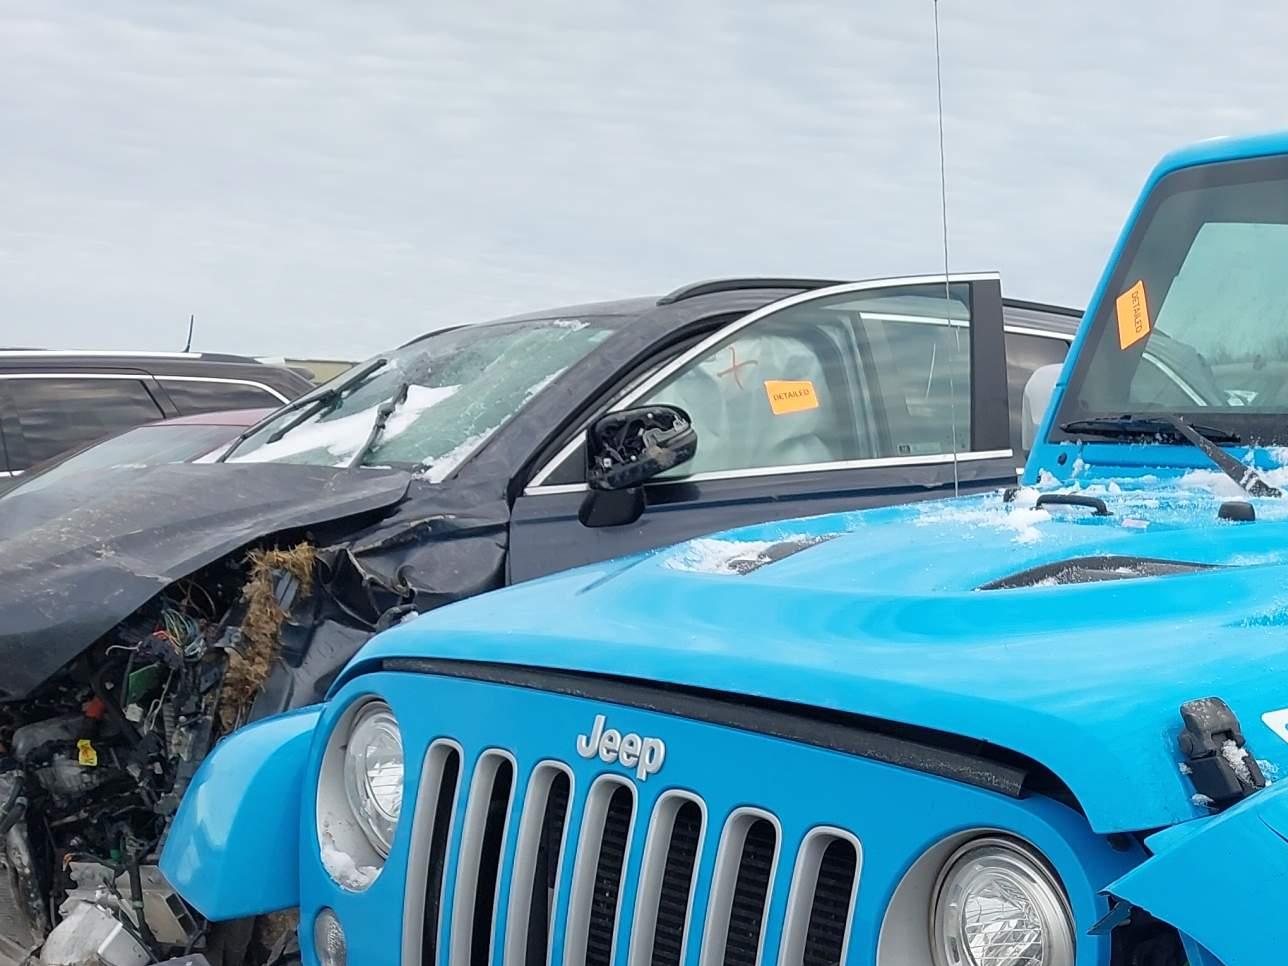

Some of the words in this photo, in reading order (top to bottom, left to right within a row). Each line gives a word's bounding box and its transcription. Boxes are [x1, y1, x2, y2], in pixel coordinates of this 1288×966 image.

[1131, 291, 1144, 334] DETAILED
[772, 388, 810, 401] DETAILED
[576, 714, 666, 781] Jeep
